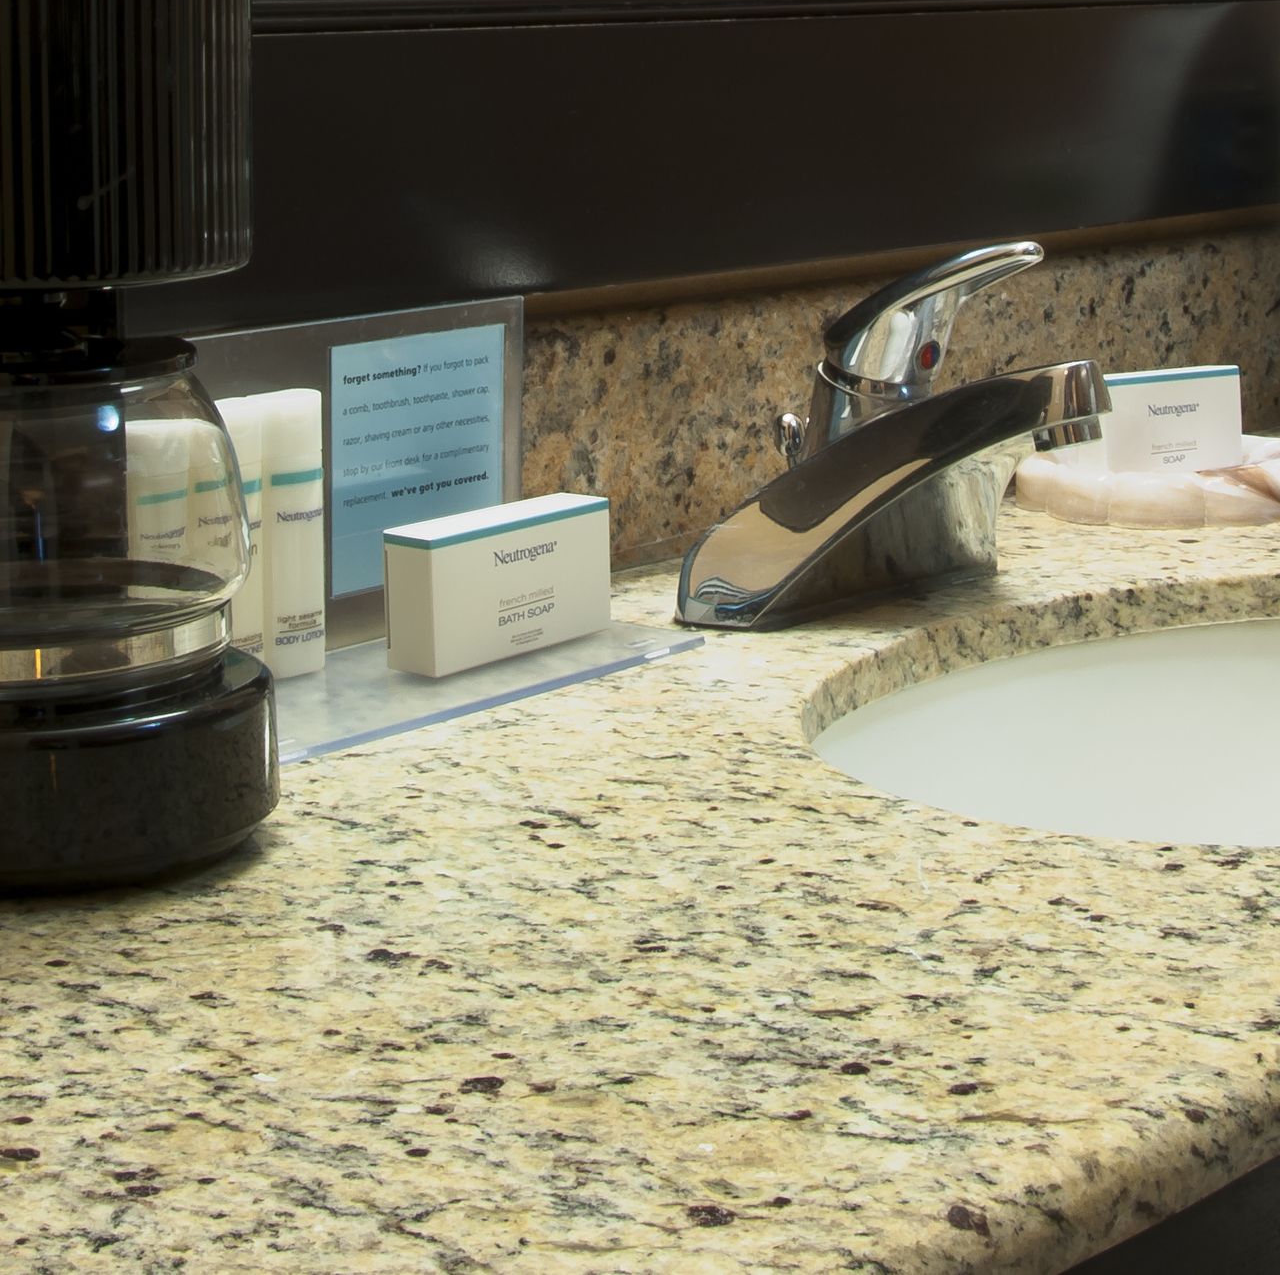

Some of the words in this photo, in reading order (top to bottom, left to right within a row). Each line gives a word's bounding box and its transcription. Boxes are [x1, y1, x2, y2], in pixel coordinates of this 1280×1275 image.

[343, 373, 370, 386] forget
[372, 365, 422, 381] something?
[429, 363, 442, 374] you
[443, 359, 464, 371] forgot
[466, 358, 472, 366] to
[474, 355, 489, 367] pack
[452, 388, 475, 399] shower
[1148, 403, 1199, 417] Neutrogena
[365, 429, 390, 444] shaving
[391, 428, 411, 438] cream
[413, 427, 420, 435] or
[422, 424, 435, 434] any
[436, 420, 453, 431] other
[343, 467, 359, 477] stop
[360, 464, 369, 475] by
[371, 463, 383, 472] our
[385, 457, 403, 469] front
[404, 455, 420, 467] desk
[422, 453, 432, 462] for
[440, 442, 490, 459] complimentary
[1163, 454, 1186, 464] SOAP
[391, 484, 417, 499] we've
[419, 481, 434, 494] got
[436, 477, 452, 492] you
[454, 470, 490, 486] covered.
[493, 541, 558, 567] Neutrogena
[499, 593, 527, 608] french
[498, 610, 525, 627] BATH
[527, 602, 555, 619] SOAP
[275, 634, 300, 646] BODY
